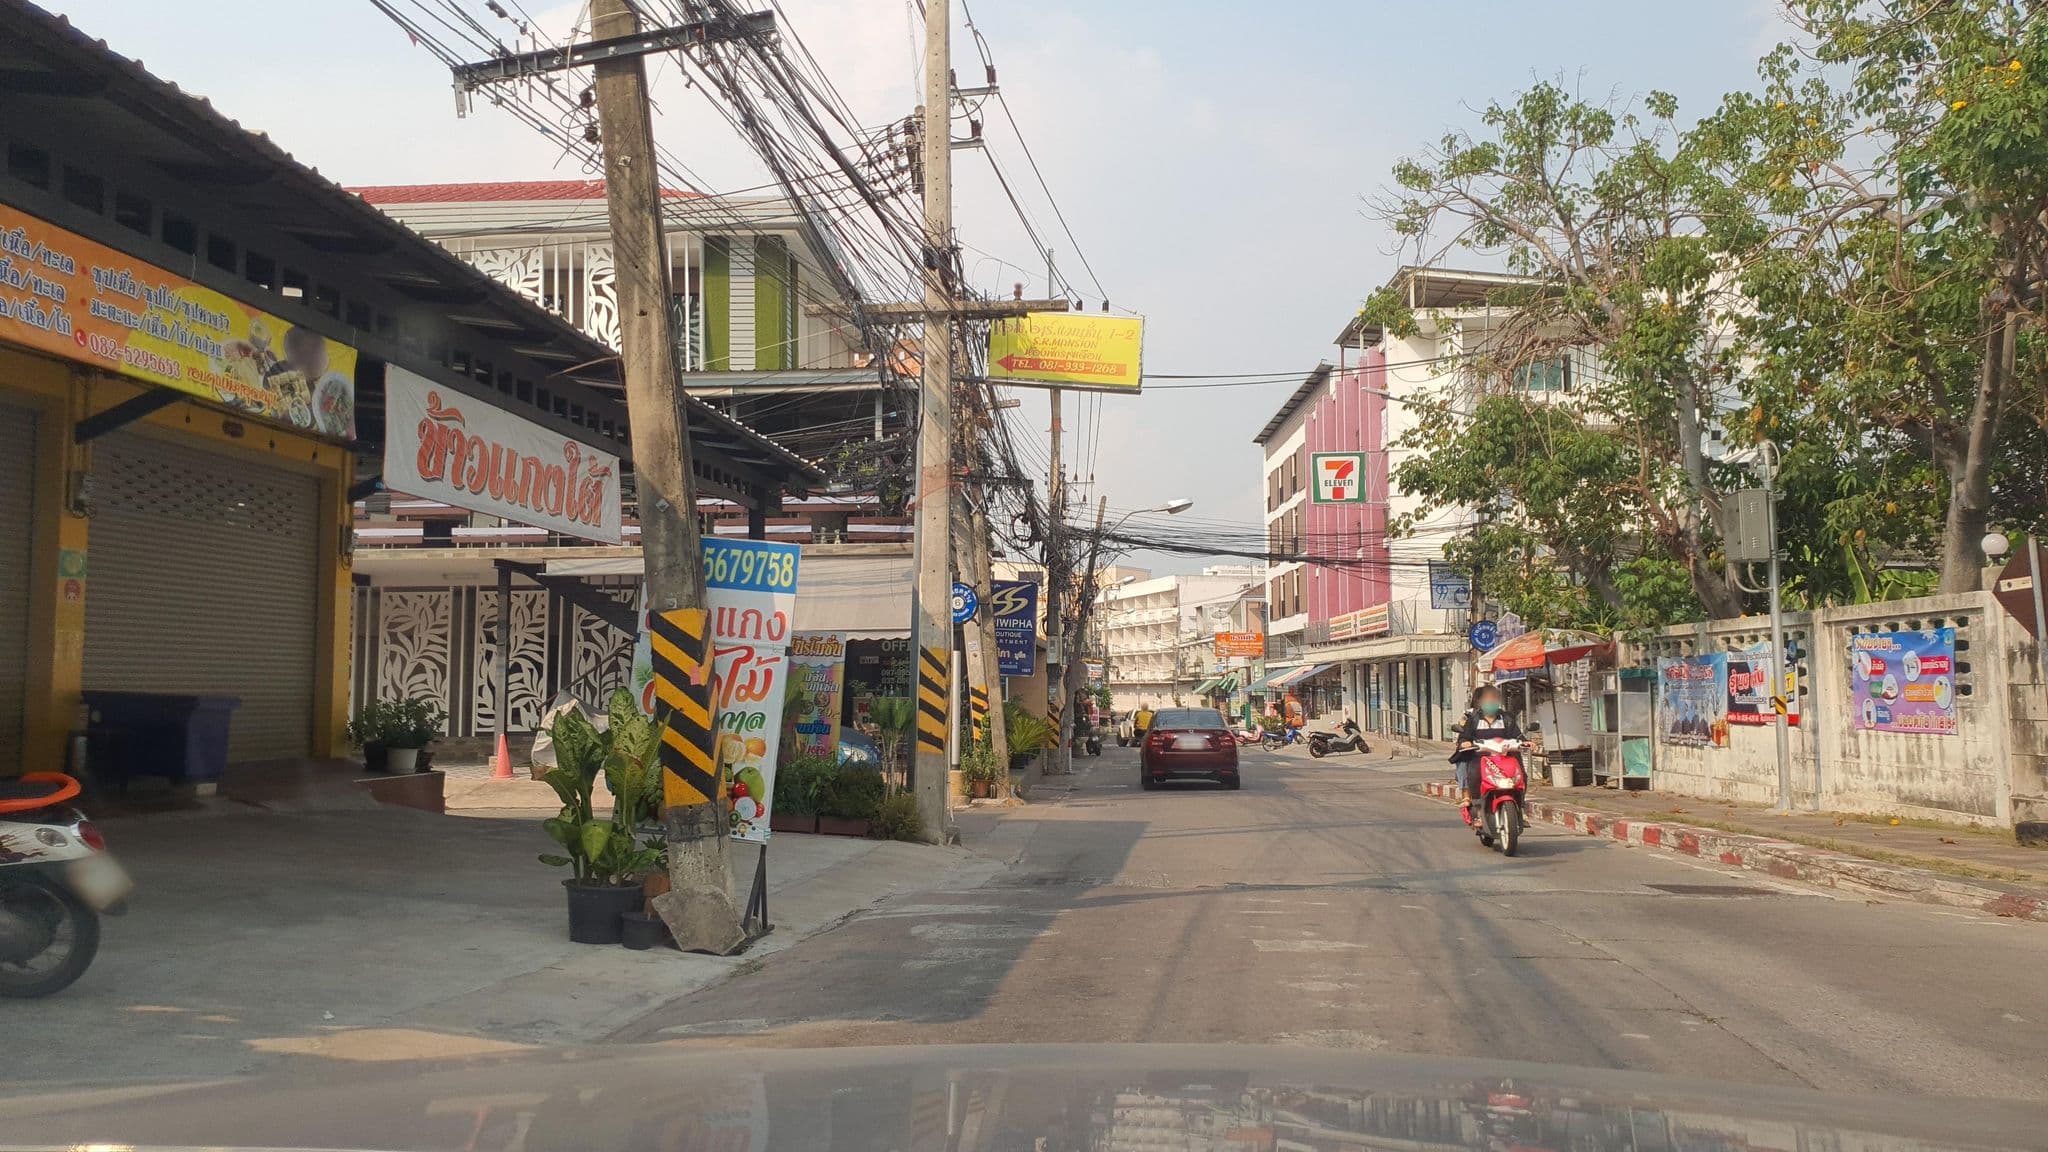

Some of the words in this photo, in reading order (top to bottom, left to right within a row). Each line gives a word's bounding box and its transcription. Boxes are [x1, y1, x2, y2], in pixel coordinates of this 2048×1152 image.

[416, 390, 613, 528] ข้าวแกงใต้
[707, 605, 788, 643] แกง
[996, 618, 1033, 629] IWIPHA
[881, 640, 911, 652] OFFI
[713, 645, 781, 709] ไม้
